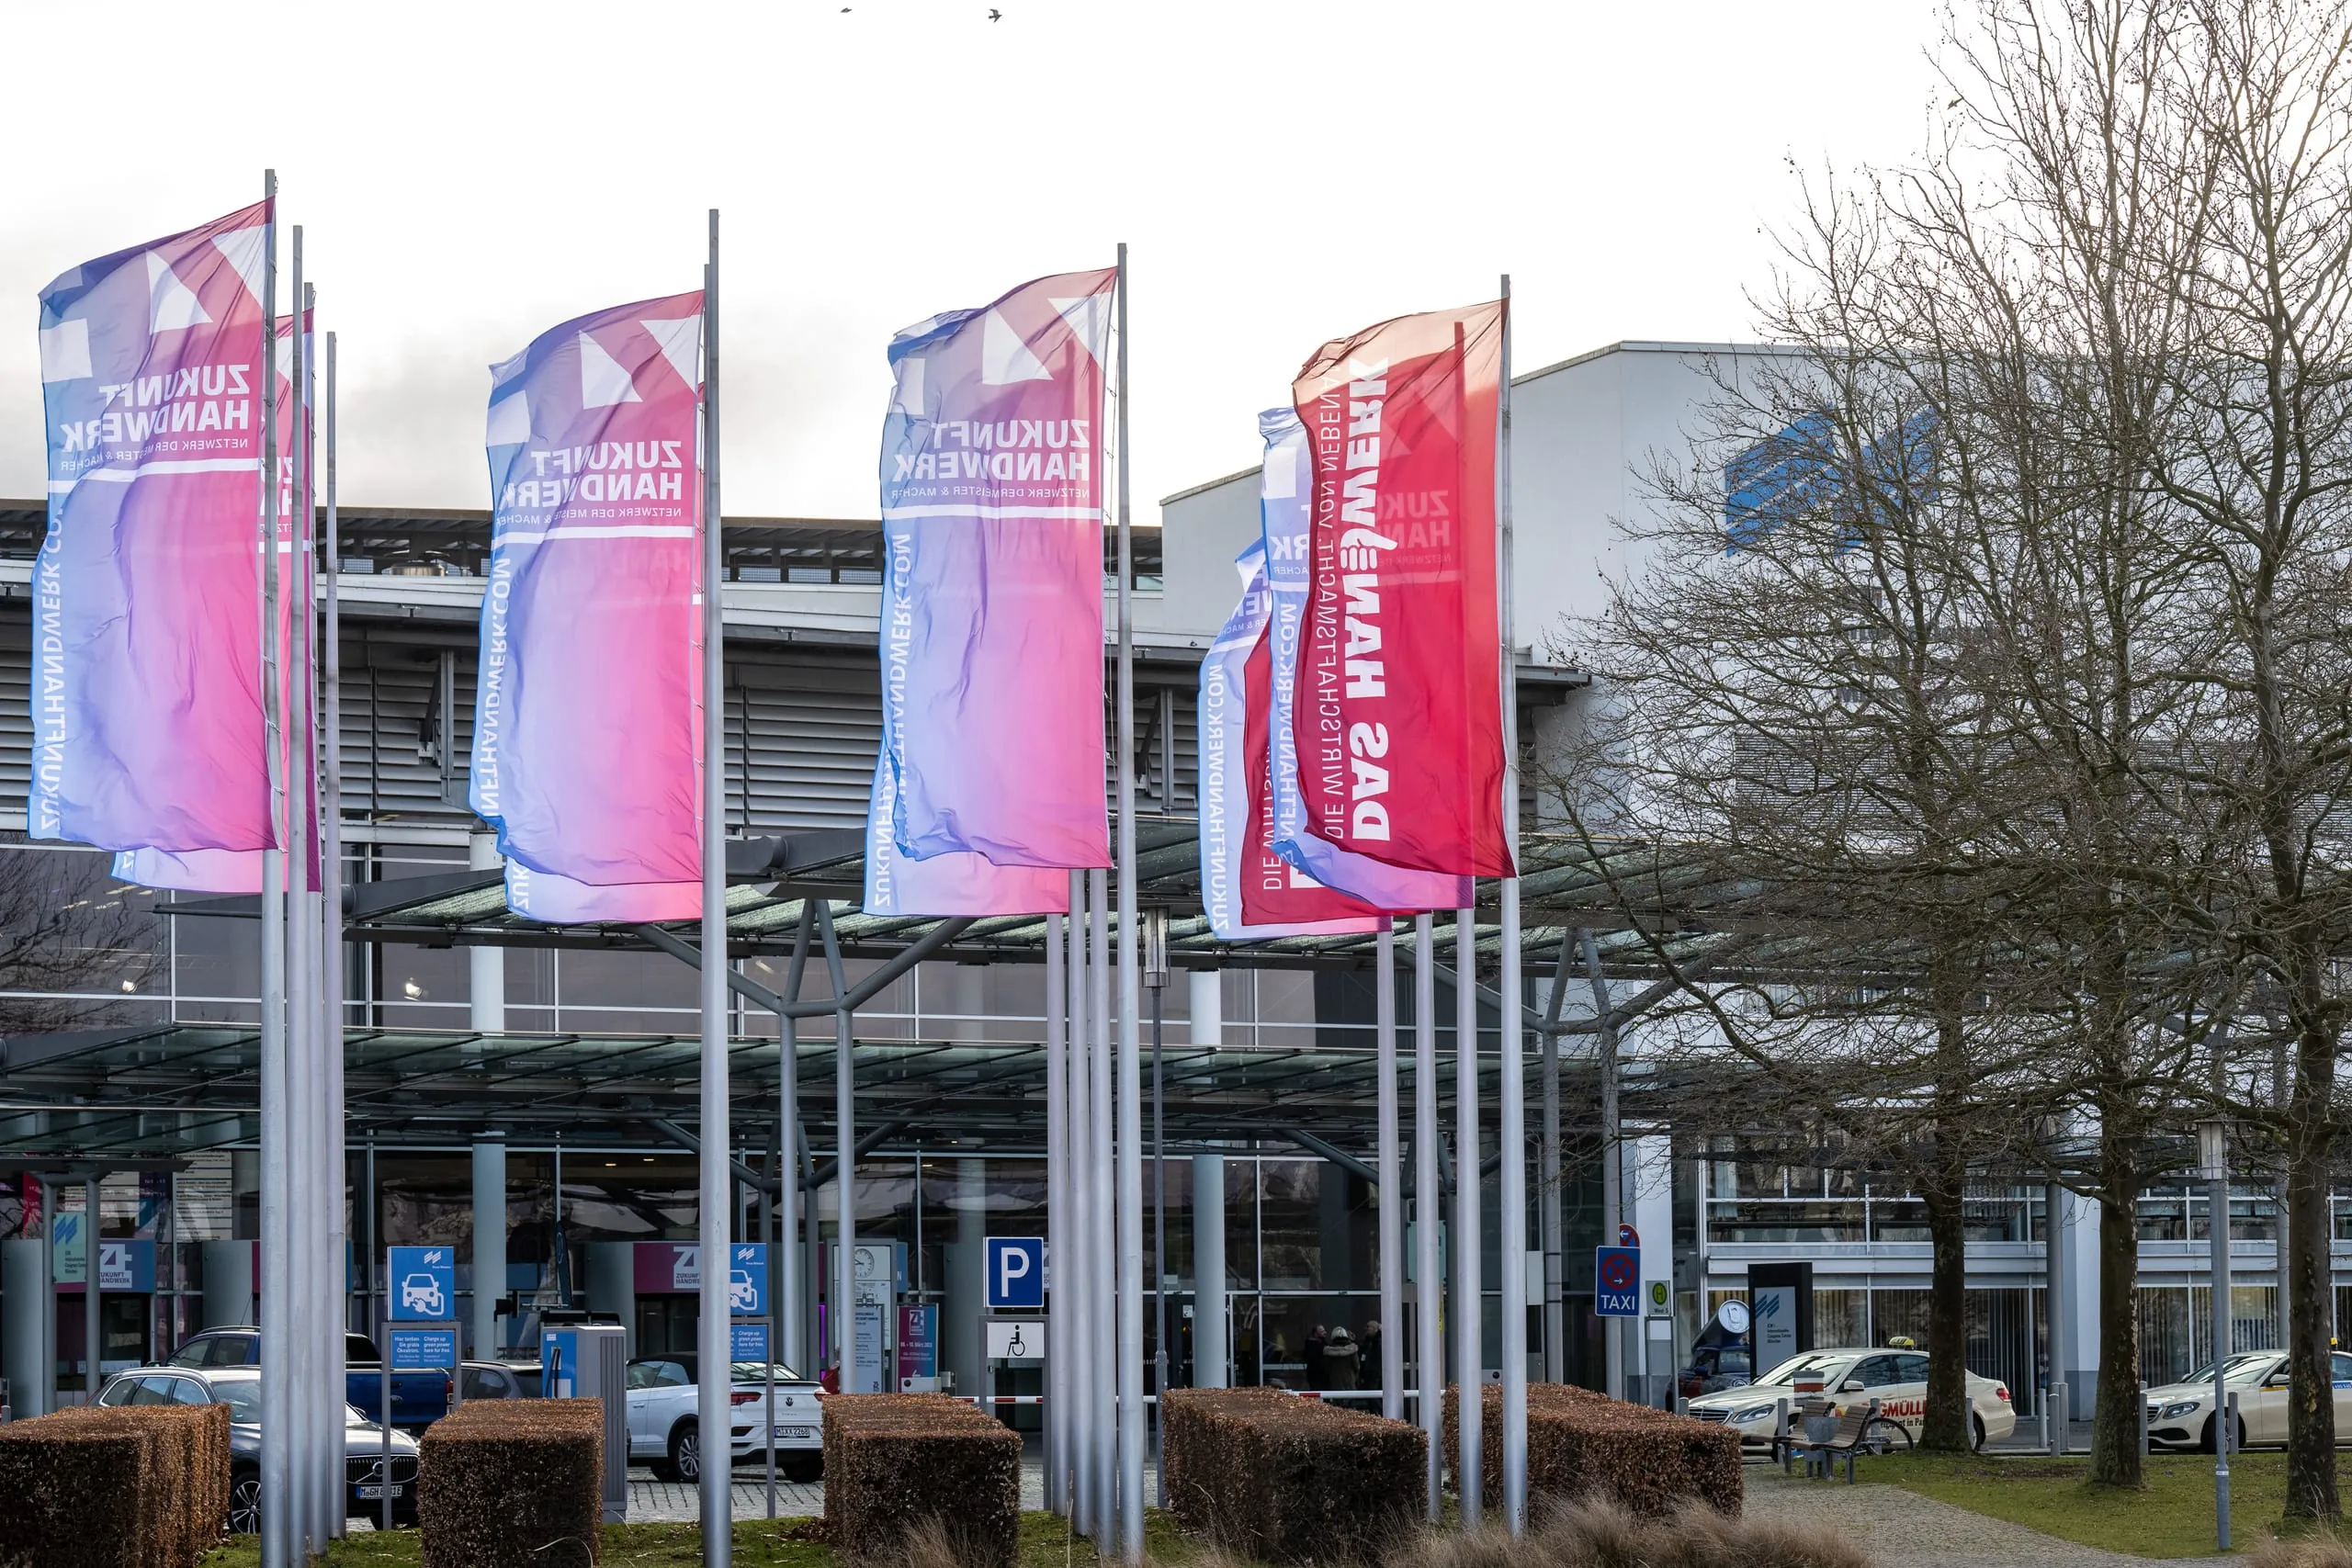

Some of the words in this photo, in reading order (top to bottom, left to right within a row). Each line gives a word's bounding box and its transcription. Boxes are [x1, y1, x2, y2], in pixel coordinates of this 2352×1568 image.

[1001, 1247, 1030, 1298] P
[1600, 1294, 1635, 1310] TAXI
[1880, 1399, 1927, 1418] GMÜLL
